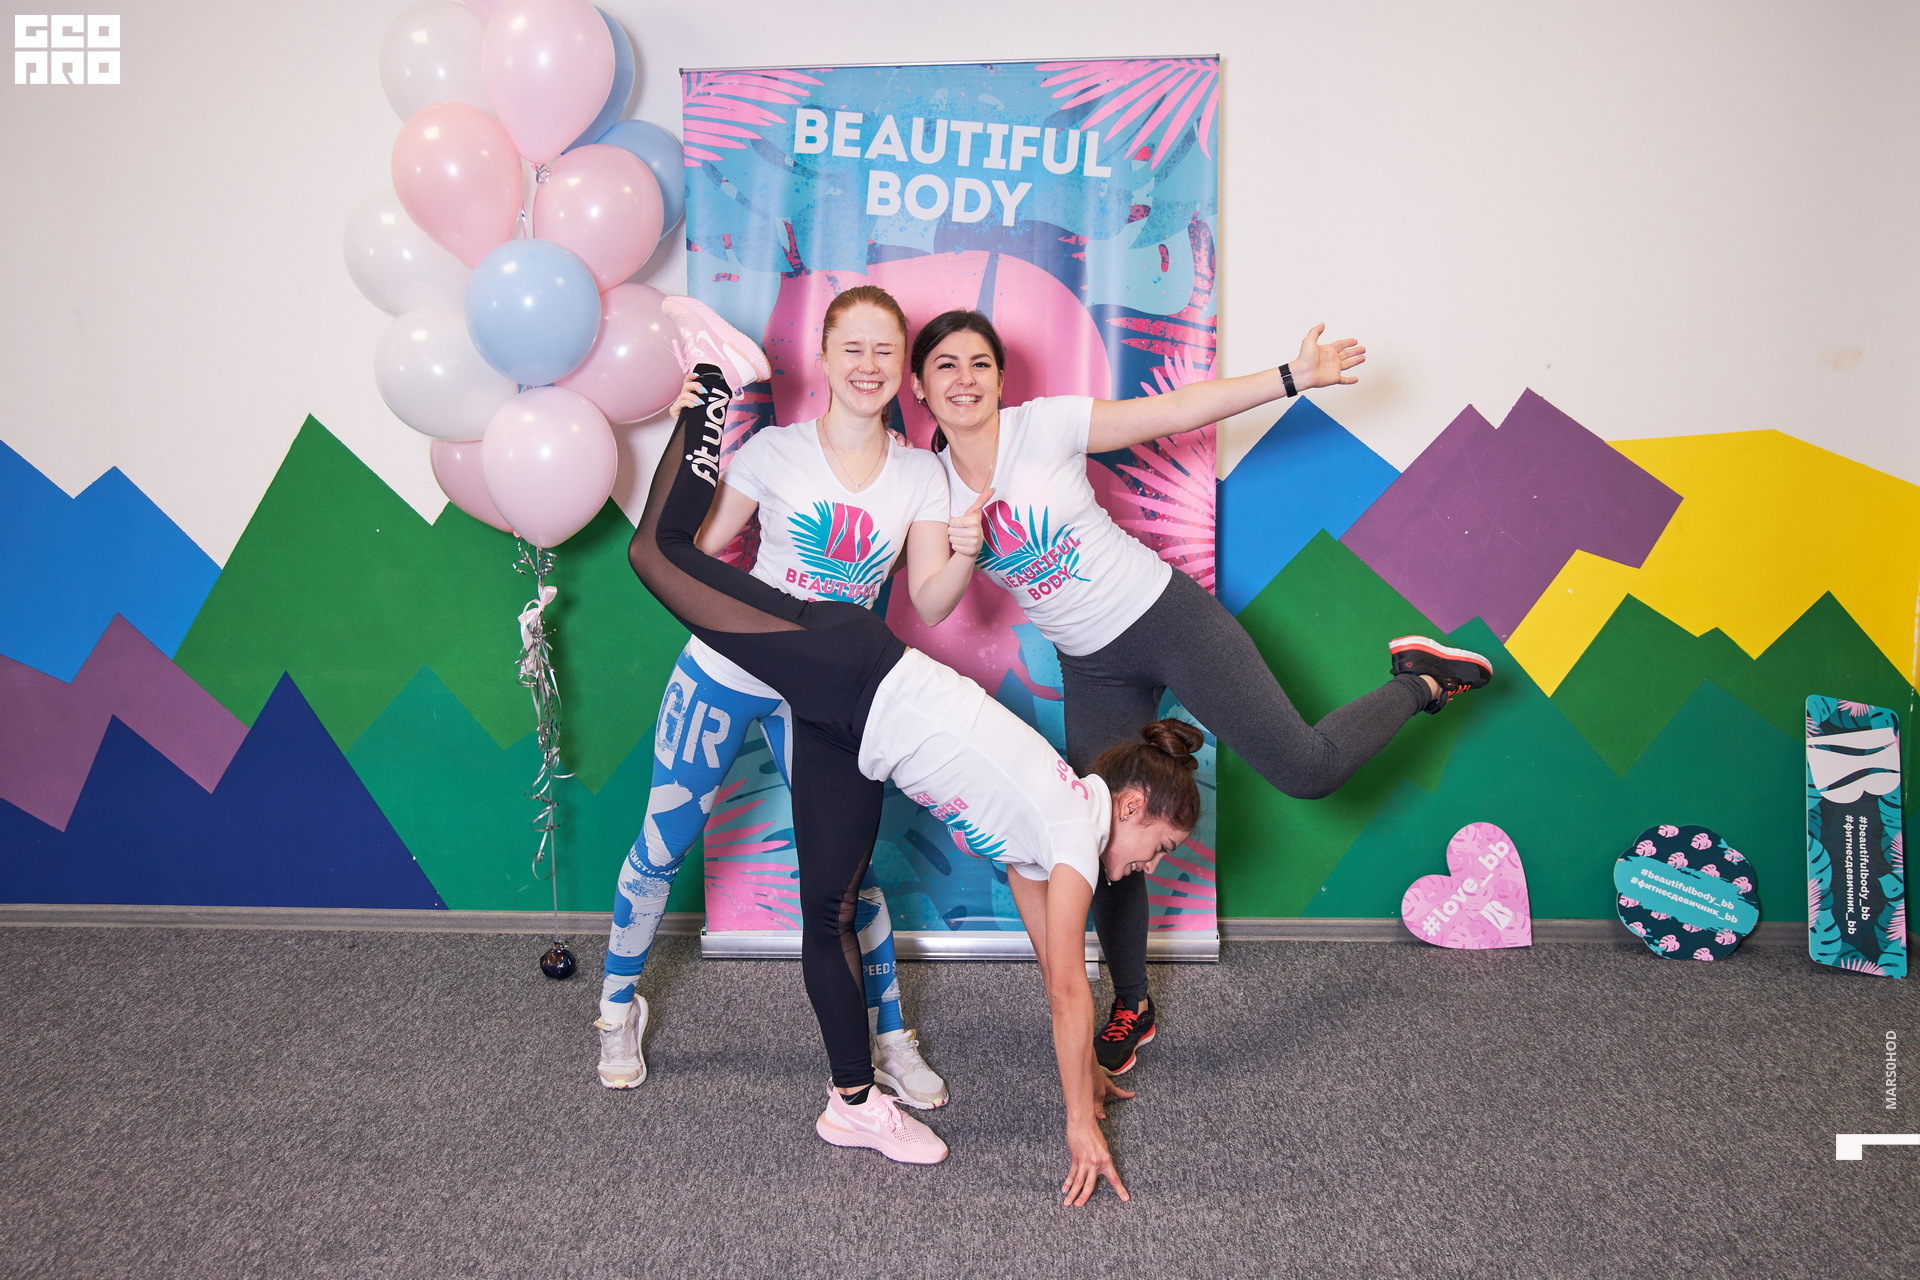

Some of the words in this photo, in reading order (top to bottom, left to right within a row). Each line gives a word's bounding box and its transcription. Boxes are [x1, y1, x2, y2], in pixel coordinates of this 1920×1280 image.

[794, 108, 1112, 178] BEAUTIFUL
[866, 170, 1033, 226] BODY
[785, 567, 877, 599] BEAUTIFUL
[1001, 535, 1082, 588] BEAUTIFUL
[1027, 564, 1073, 601] BODY
[1422, 841, 1510, 937] #love_bb
[1640, 868, 1735, 910] #beautifulbody_bb
[1844, 814, 1858, 935] #фитнесдевичник_bb
[1858, 815, 1871, 921] #beautifulbody_bb
